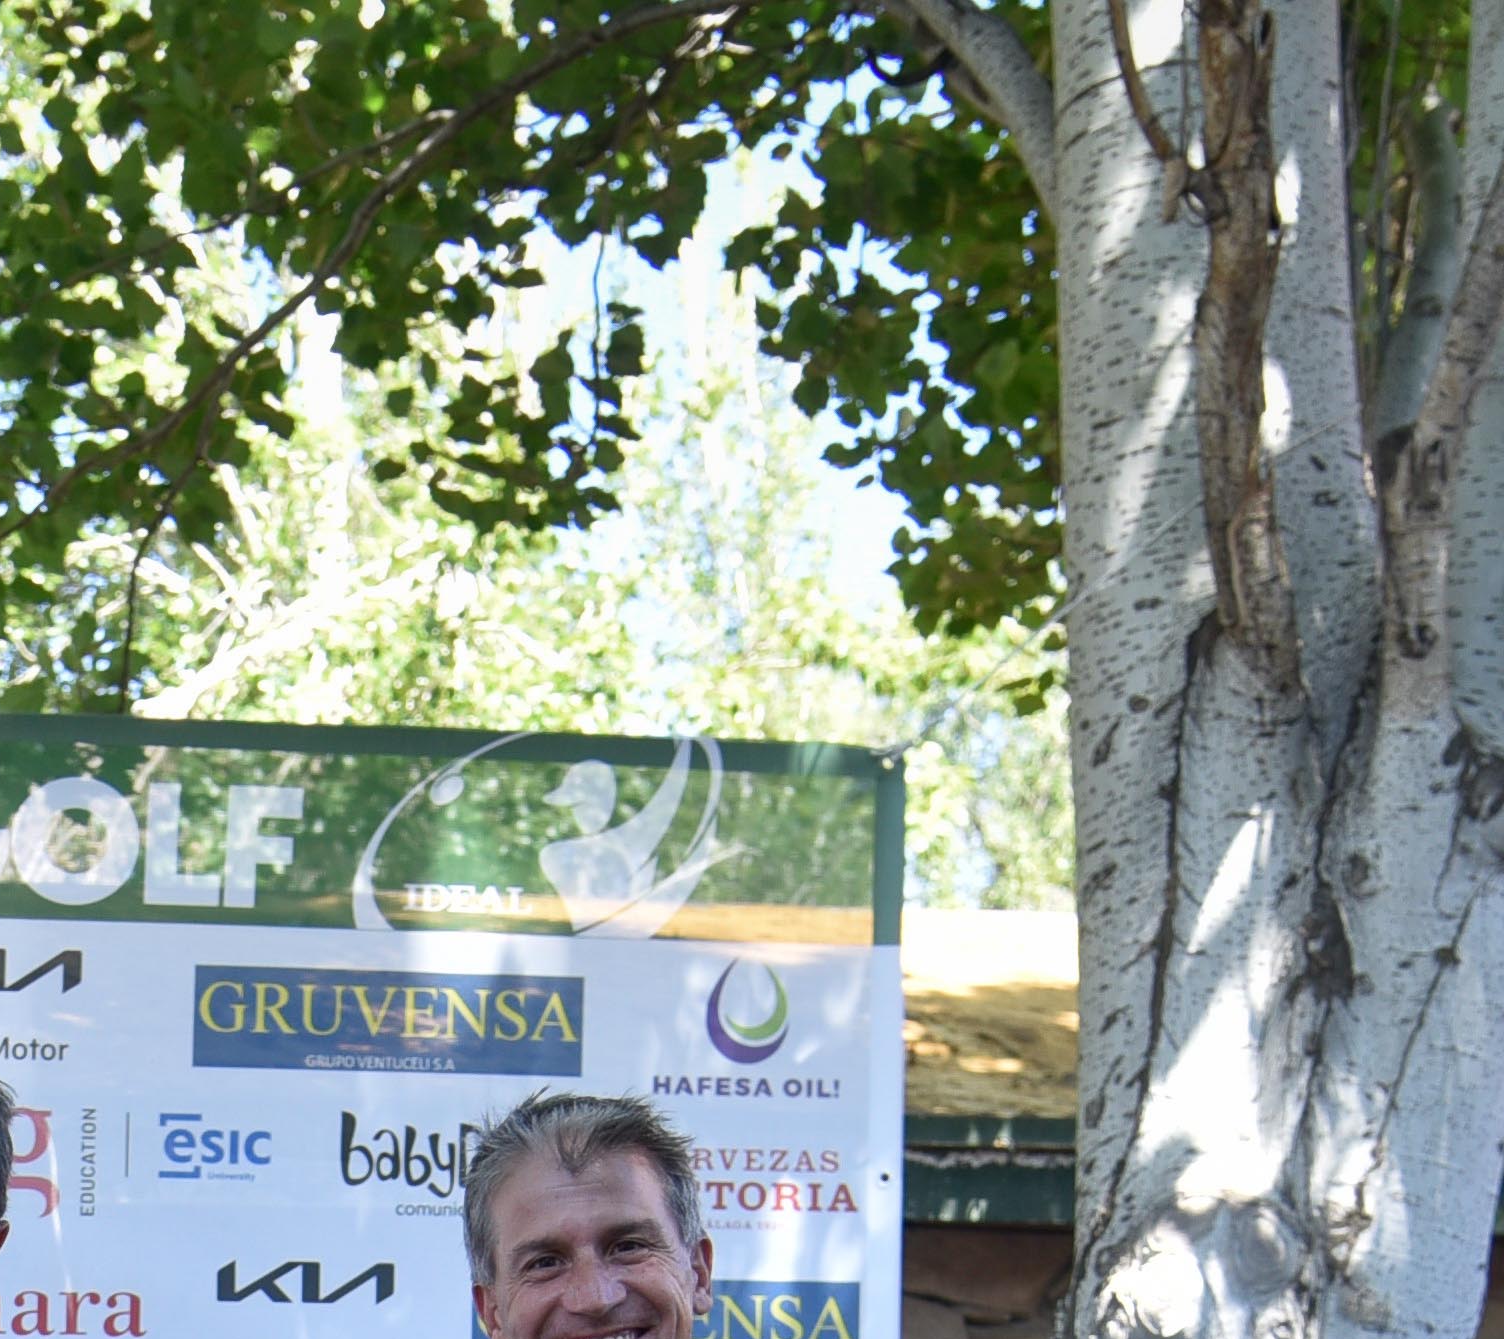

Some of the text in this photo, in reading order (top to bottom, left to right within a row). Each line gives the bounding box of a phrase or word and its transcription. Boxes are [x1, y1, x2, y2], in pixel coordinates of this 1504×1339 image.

[403, 883, 533, 915] IDEAL
[198, 981, 577, 1042] GRUVENSA
[653, 1075, 840, 1098] HAFESA OIL!
[80, 1108, 97, 1217] EDUCATION
[692, 1148, 840, 1172] RVEZAS
[695, 1181, 858, 1213] TORIA
[216, 1260, 395, 1305] KIA
